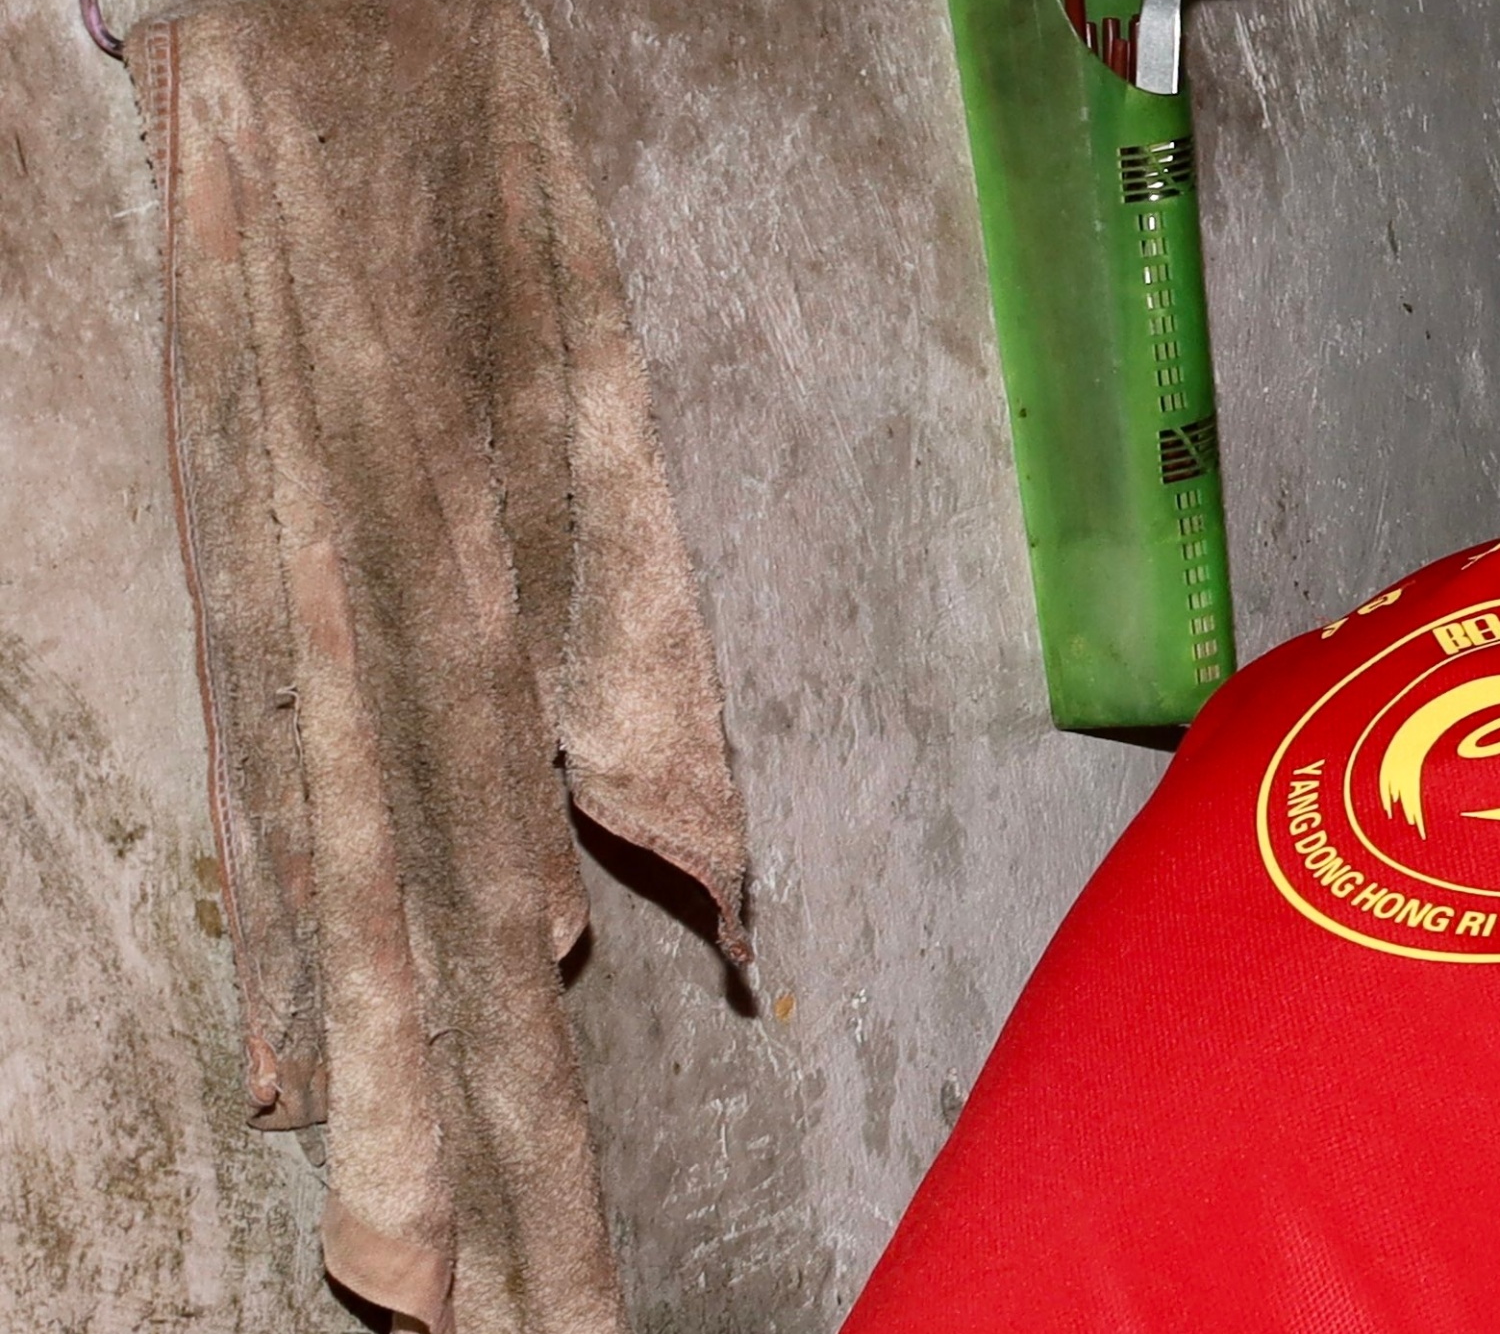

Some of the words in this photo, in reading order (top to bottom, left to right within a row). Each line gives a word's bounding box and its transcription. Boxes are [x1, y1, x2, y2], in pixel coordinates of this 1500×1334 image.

[1287, 759, 1326, 836] YANG
[1294, 830, 1365, 898] DONG
[1351, 881, 1455, 933] HONG
[1455, 910, 1497, 937] RI
